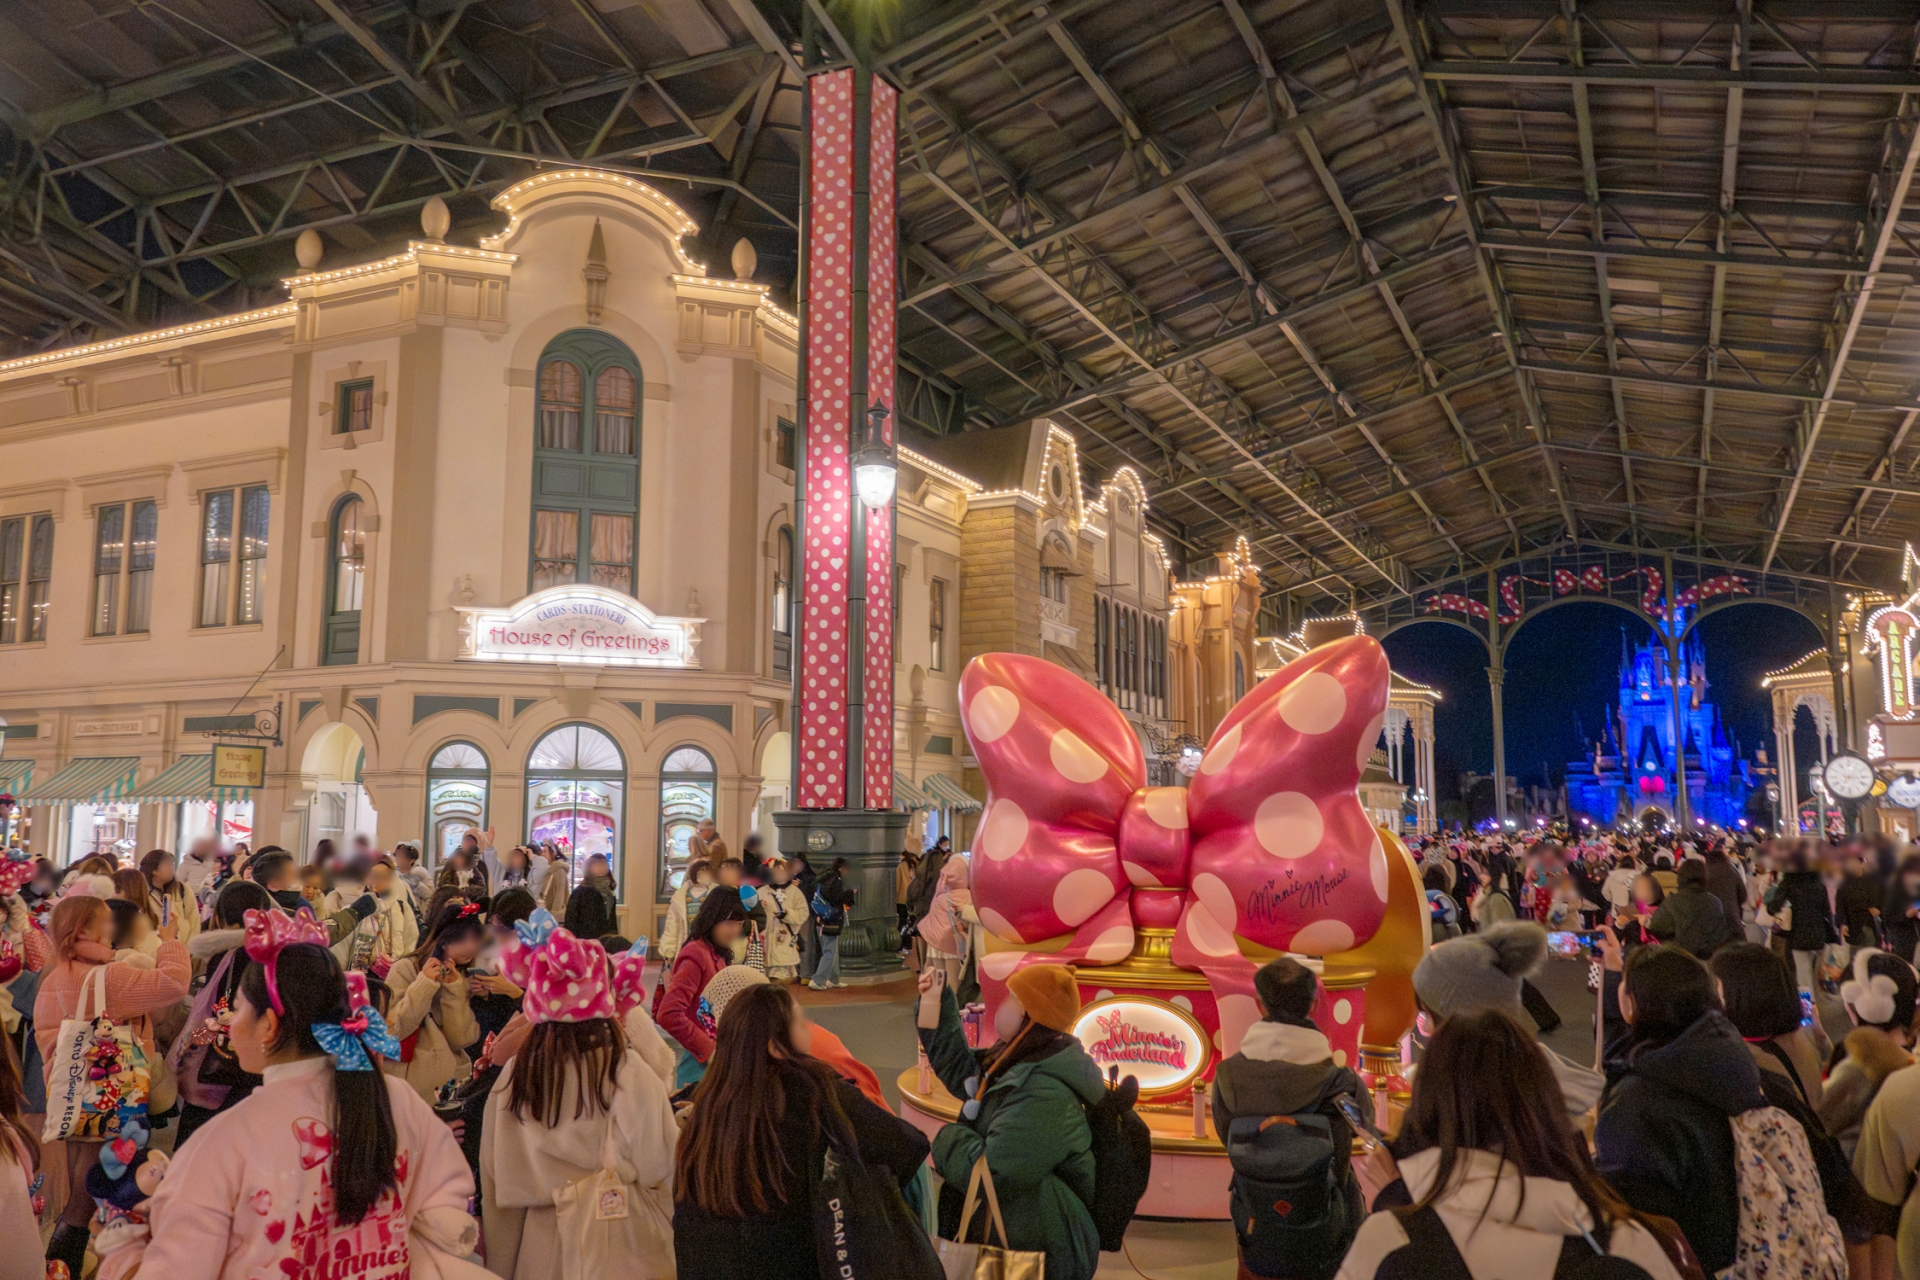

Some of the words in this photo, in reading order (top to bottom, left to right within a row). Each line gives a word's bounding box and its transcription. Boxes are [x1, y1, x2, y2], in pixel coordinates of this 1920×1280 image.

[489, 627, 552, 646] House
[557, 629, 576, 650] of
[581, 630, 670, 654] Greetings
[219, 768, 258, 781] Greetings
[1247, 873, 1303, 925] Minnie
[1300, 868, 1350, 909] Mouse
[1106, 1022, 1180, 1050] Minnie's
[1089, 1040, 1187, 1071] Funderland
[828, 1198, 846, 1246] DEAN
[837, 1249, 848, 1261] &
[840, 1264, 855, 1280] D
